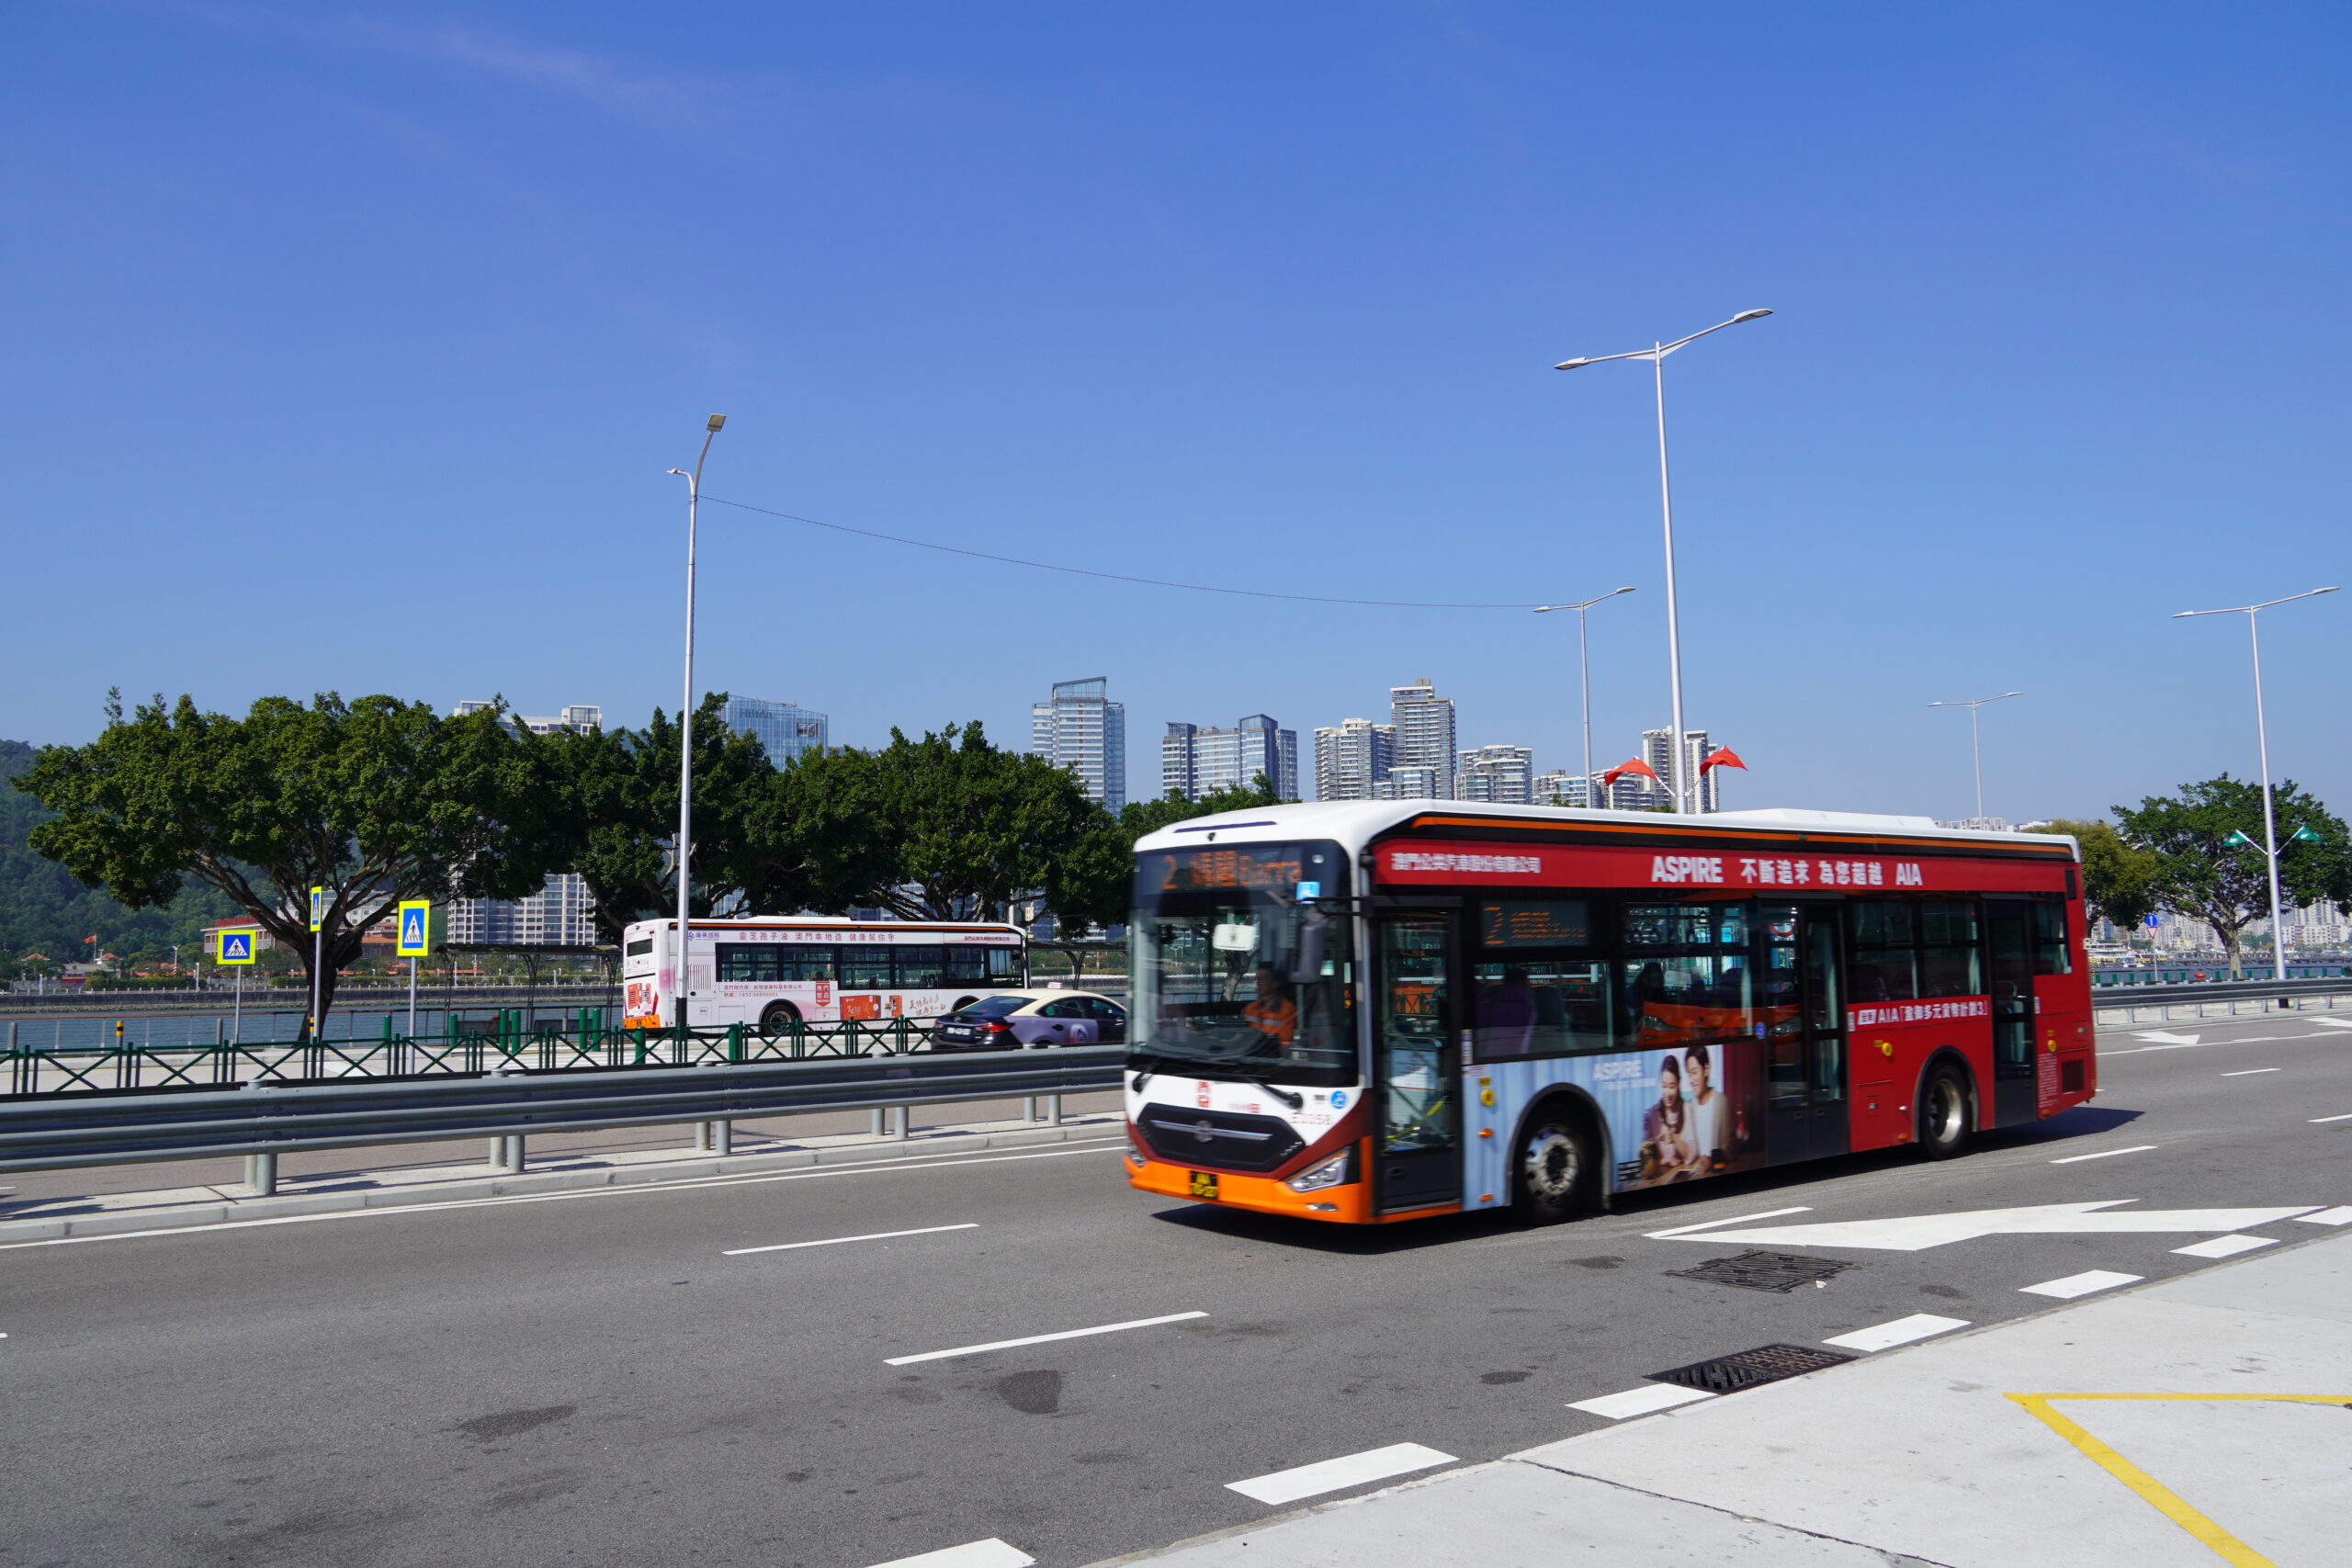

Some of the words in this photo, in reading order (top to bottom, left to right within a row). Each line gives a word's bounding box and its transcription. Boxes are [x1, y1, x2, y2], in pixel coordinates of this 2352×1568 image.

[1651, 855, 1724, 883] ASPIRE
[1739, 858, 1810, 885] 不斷追求
[1895, 863, 1923, 886] AIA
[1592, 1059, 1642, 1080] ASPIRE
